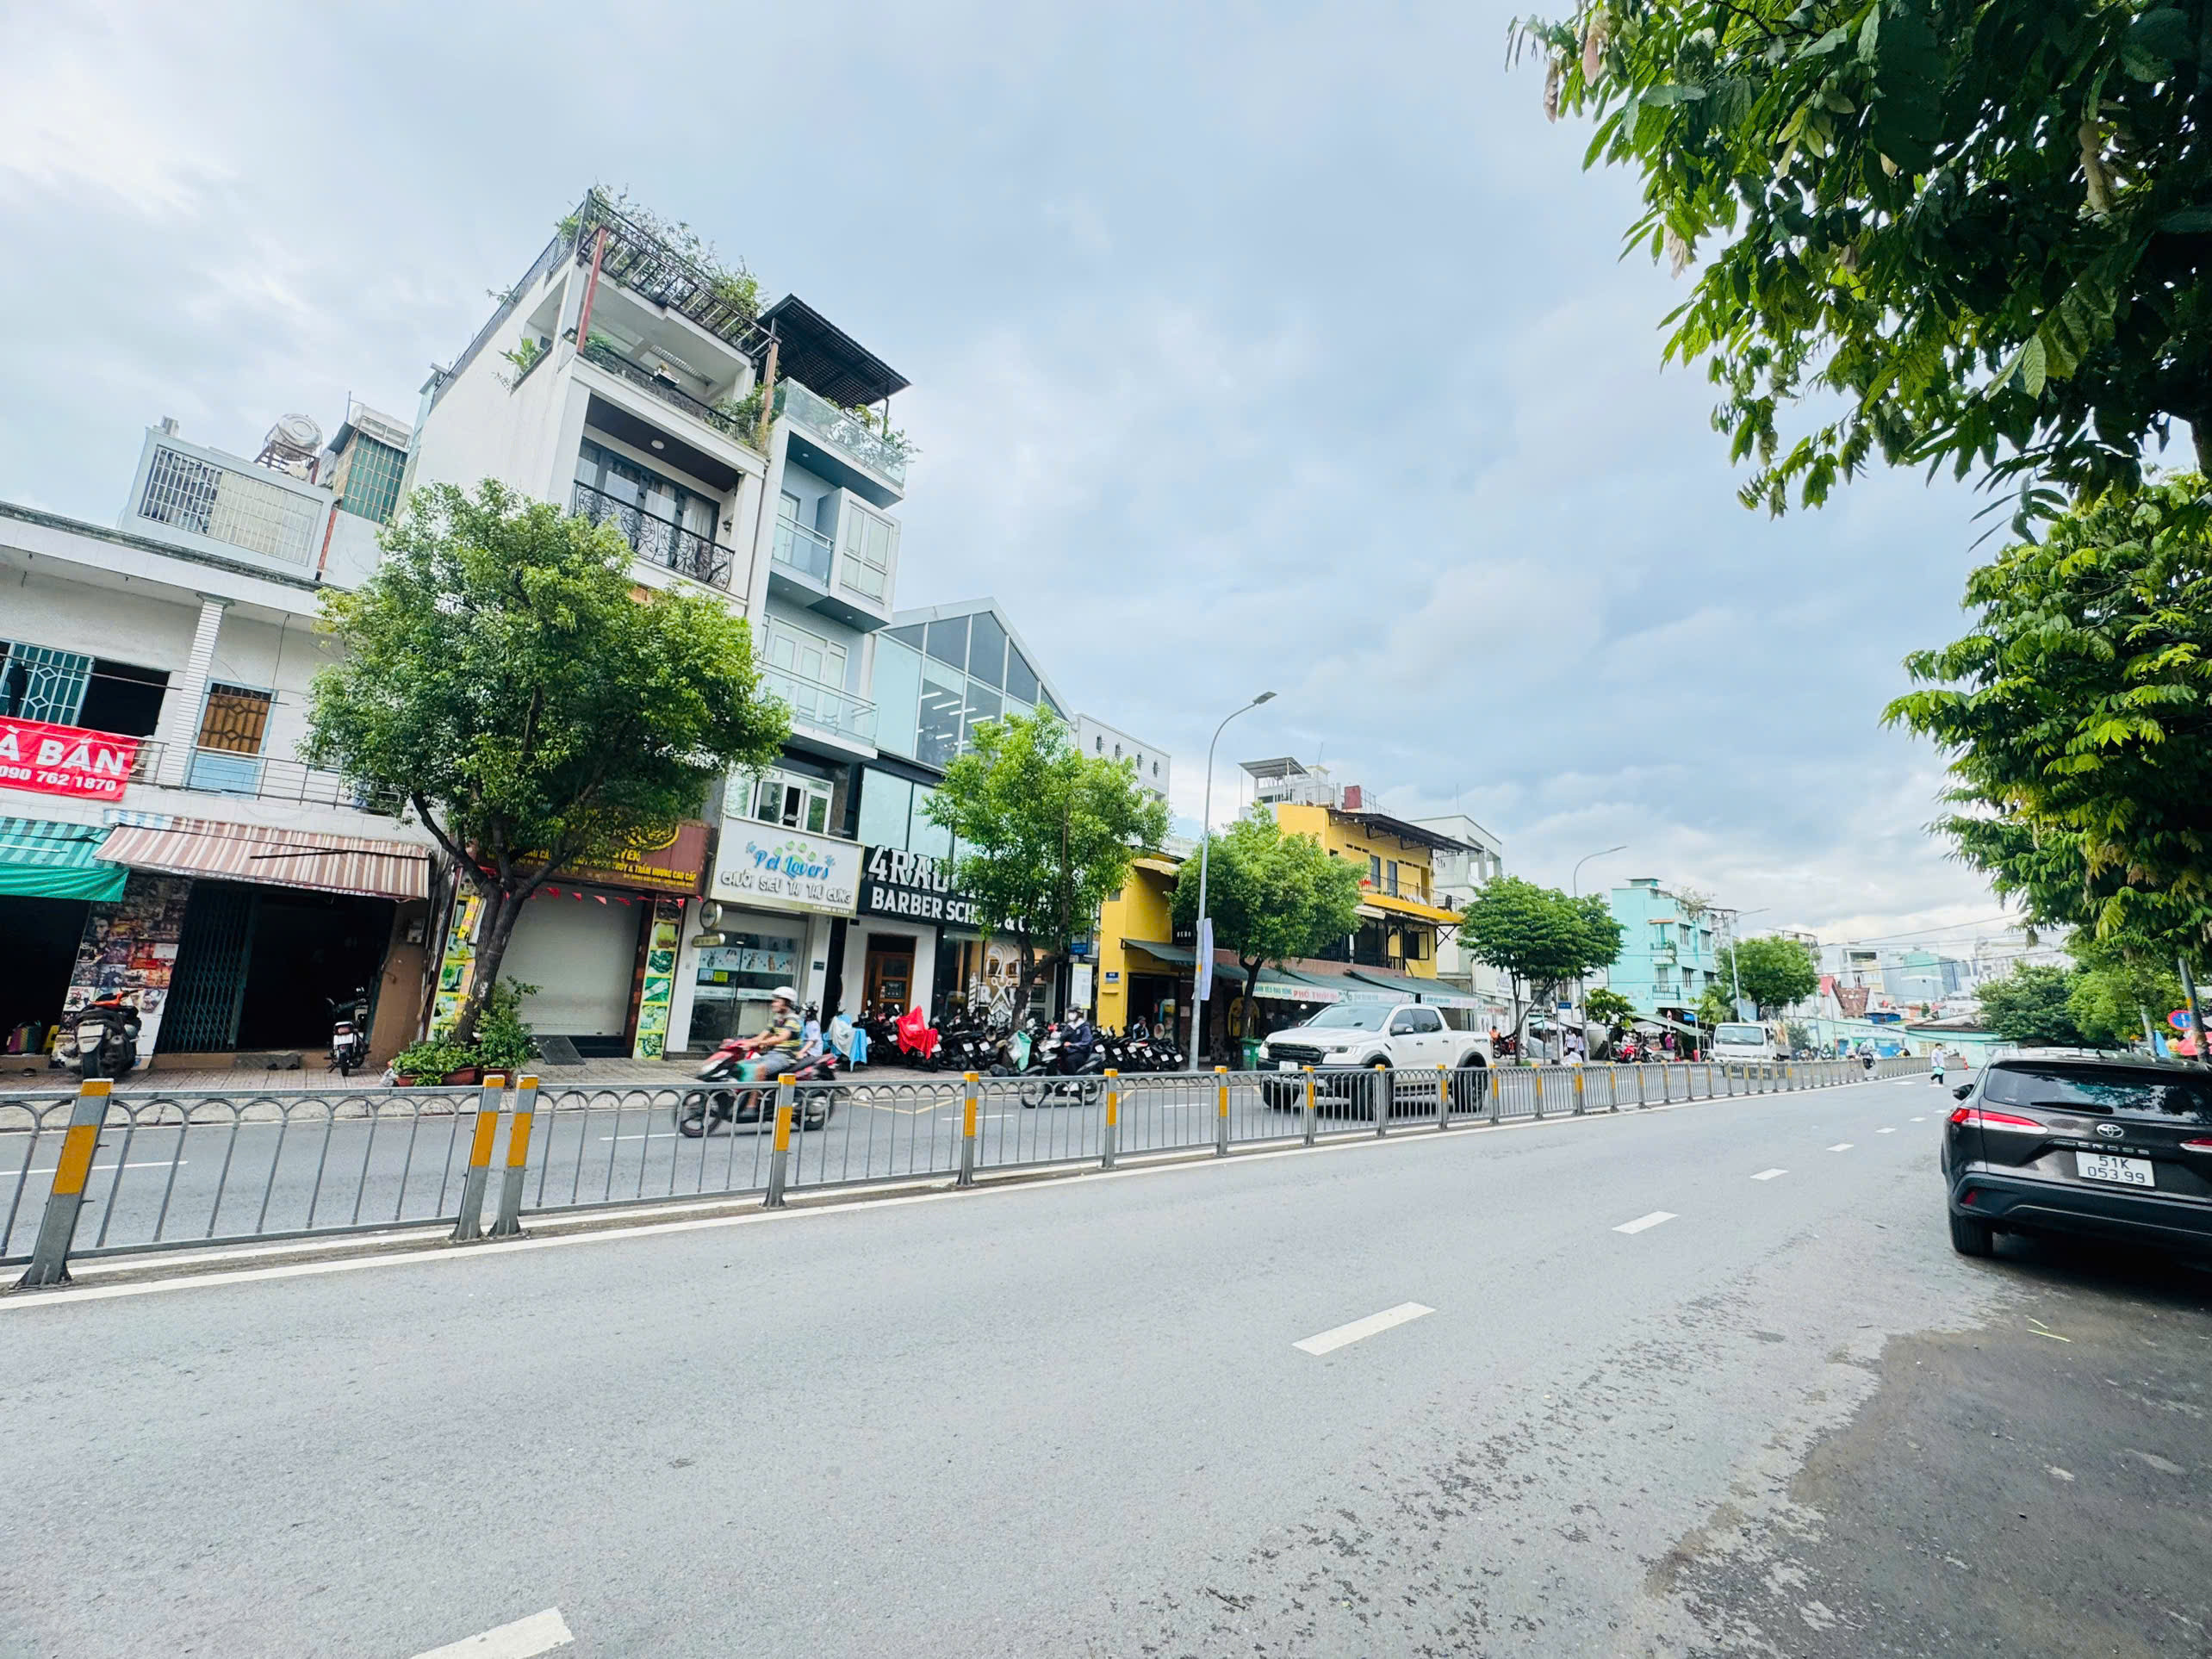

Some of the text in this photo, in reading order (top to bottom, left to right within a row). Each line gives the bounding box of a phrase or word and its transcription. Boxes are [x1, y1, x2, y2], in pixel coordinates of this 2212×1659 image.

[35, 737, 125, 776] BÁN
[36, 771, 70, 786] 762
[75, 776, 117, 792] 1870
[754, 849, 829, 880] Pet Lovers
[871, 885, 942, 920] BARBER
[2087, 1165, 2146, 1184] 053.99
[2098, 1155, 2129, 1171] 51K
